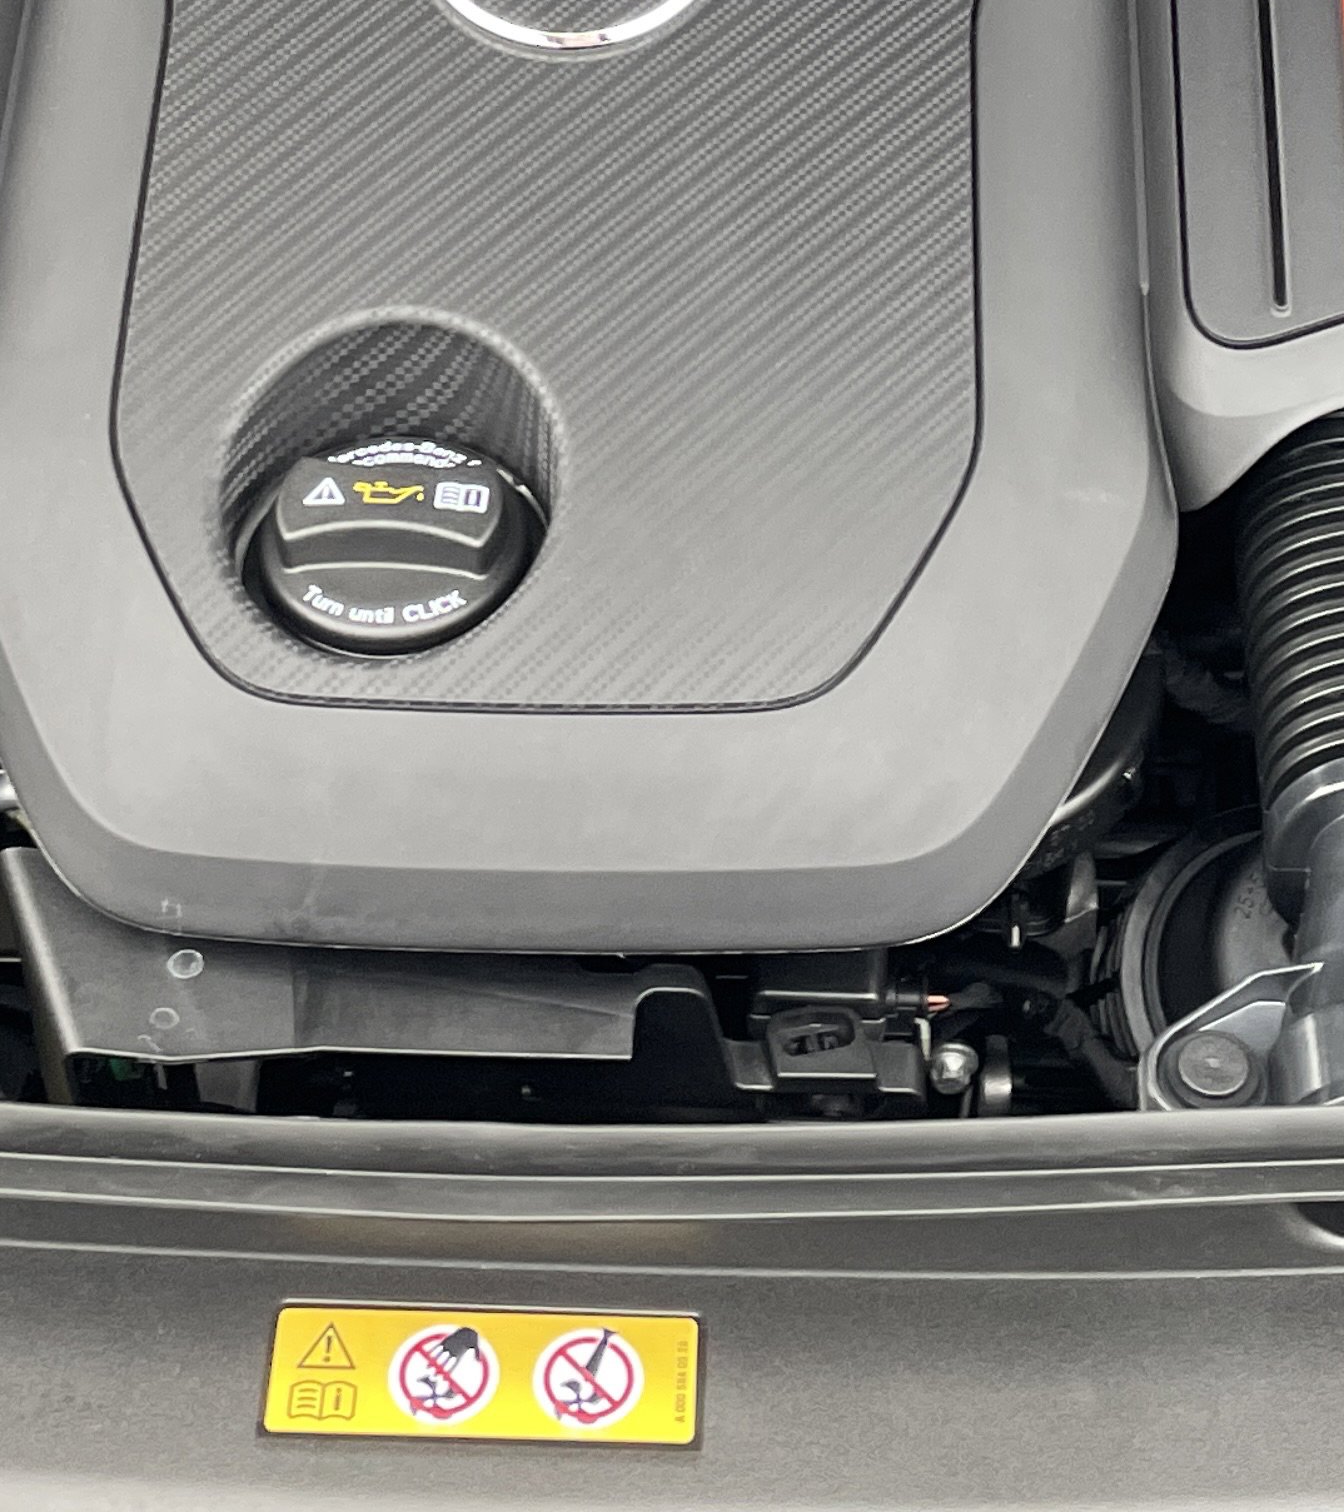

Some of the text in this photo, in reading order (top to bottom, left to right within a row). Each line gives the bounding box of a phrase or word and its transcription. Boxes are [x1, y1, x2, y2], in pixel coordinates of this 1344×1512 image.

[303, 584, 468, 624] Turn until CLICK
